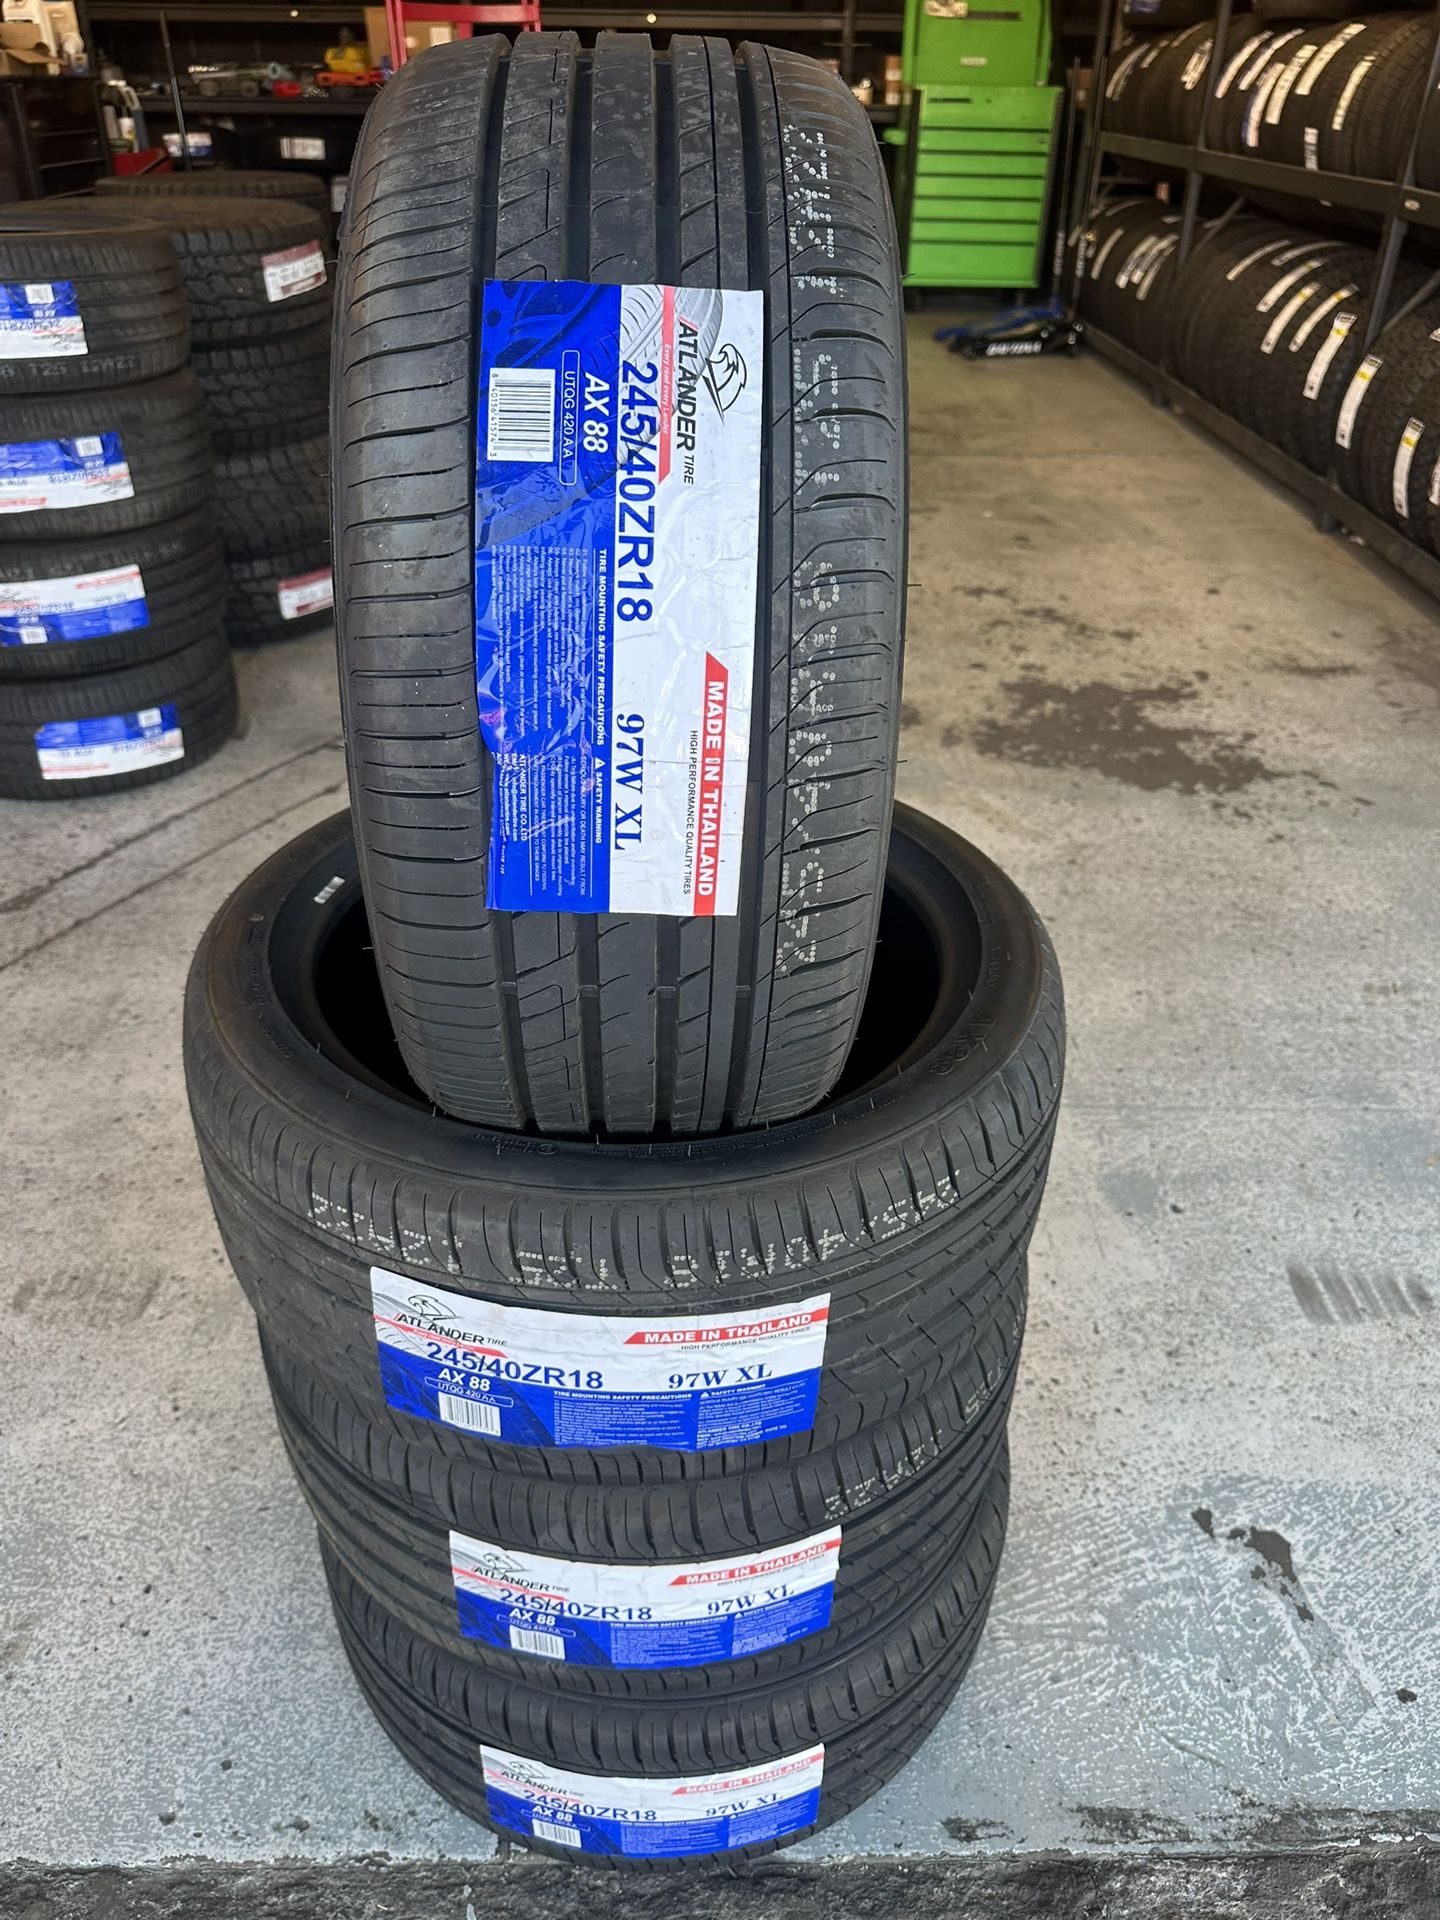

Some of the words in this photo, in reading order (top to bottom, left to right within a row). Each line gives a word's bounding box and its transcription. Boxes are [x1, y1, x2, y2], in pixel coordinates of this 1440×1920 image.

[663, 344, 672, 366] Every
[564, 371, 576, 409] UTQG
[663, 366, 671, 384] road
[676, 317, 698, 451] ATLANDER
[584, 372, 610, 416] AX
[662, 385, 670, 406] every
[563, 412, 574, 435] 420
[662, 408, 670, 434] Lander
[582, 420, 609, 453] 88
[684, 455, 694, 485] TIRE
[616, 360, 658, 622] 245/40ZR18
[598, 576, 606, 632] MOUNTING
[598, 634, 606, 673] SAFETY
[705, 680, 724, 748] MADE
[616, 714, 645, 794] 97W
[689, 730, 698, 754] HIGH
[703, 758, 722, 782] IN
[686, 756, 697, 830] PERFORMANCE
[580, 810, 586, 820] OR
[614, 802, 642, 851] XL
[684, 831, 694, 868] QUALITY
[698, 788, 719, 896] THAILAND
[684, 871, 692, 894] TIRES
[393, 1313, 485, 1345] ATLANDER
[487, 1337, 507, 1346] TIRE
[644, 1332, 696, 1344] MADE
[701, 1329, 721, 1341] IN
[726, 1314, 812, 1338] THAILAND
[701, 1338, 757, 1350] PERFORMANCE
[427, 1341, 604, 1389] 245/40ZR18
[438, 1368, 464, 1386] AX
[469, 1376, 491, 1392] 88
[668, 1369, 730, 1390] 97W
[735, 1363, 773, 1384] XL
[553, 1390, 571, 1398] TIRE
[571, 1392, 611, 1400] MOUNTING
[641, 1393, 692, 1401] PRECAUTIONS
[472, 1566, 550, 1592] ATLANDER
[686, 1573, 729, 1584] MADE
[734, 1566, 750, 1577] IN
[755, 1544, 827, 1571] THAILAND
[500, 1588, 652, 1620] 245/40ZR18
[708, 1595, 756, 1614] 97W
[764, 1584, 794, 1603] XL
[509, 1607, 533, 1622] AX
[536, 1614, 556, 1626] 88
[500, 1770, 568, 1796] ATLANDER
[685, 1783, 725, 1794] MADE
[729, 1779, 743, 1788] IN
[747, 1757, 812, 1784] THAILAND
[523, 1789, 657, 1821] 245/40ZR18
[531, 1804, 554, 1818] AX
[556, 1811, 573, 1822] 88
[706, 1801, 749, 1817] 97W
[757, 1792, 783, 1807] XL
